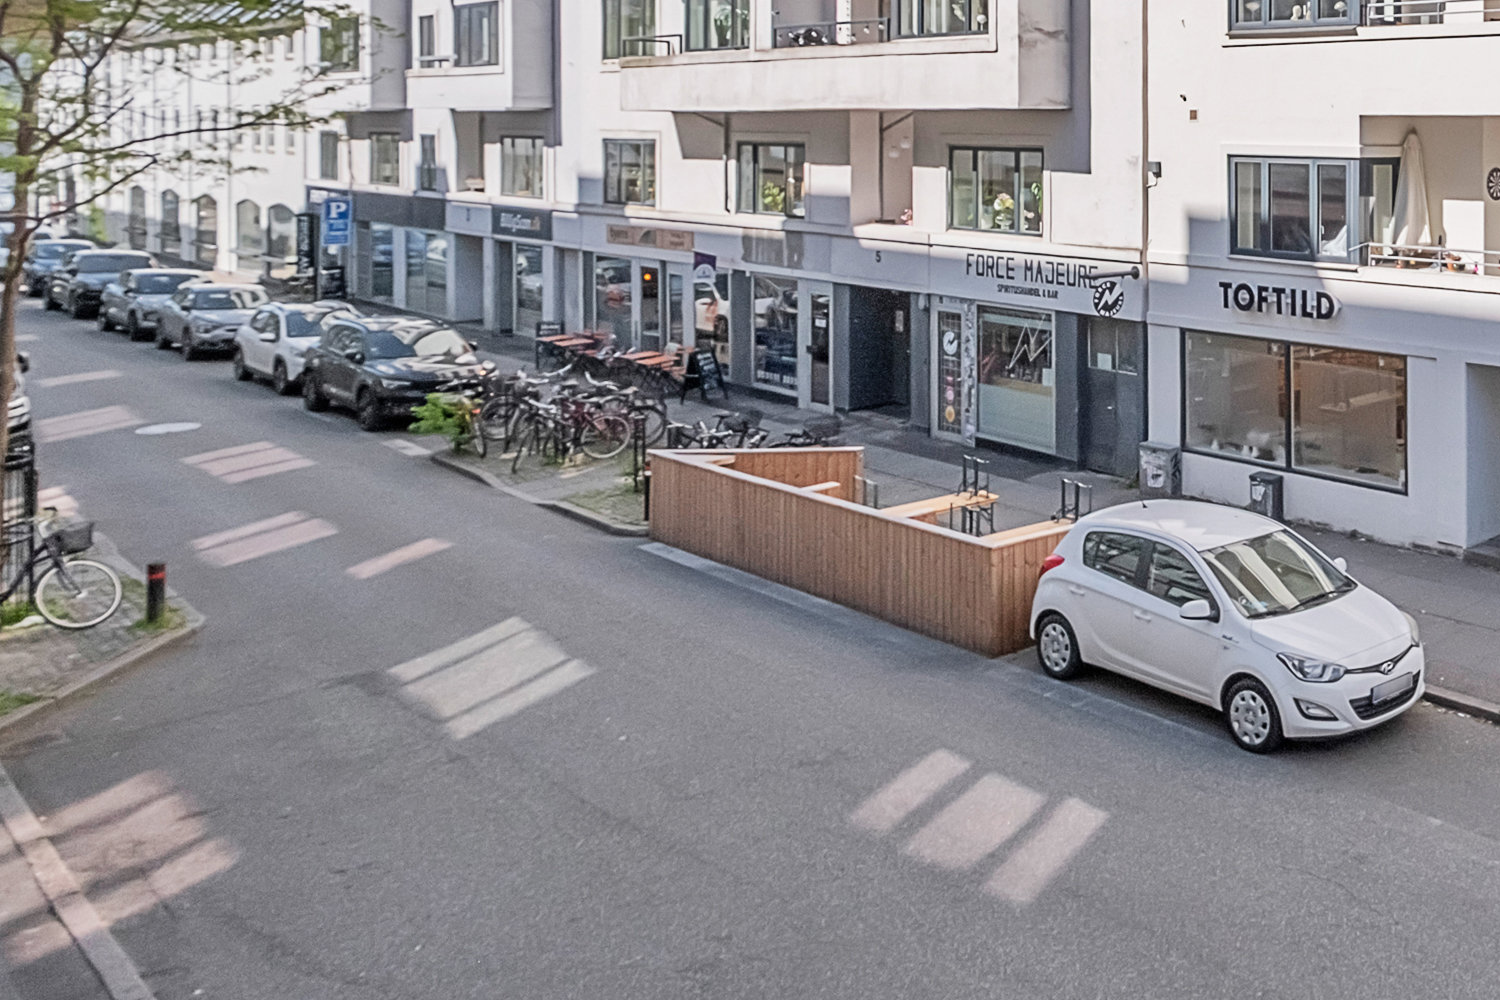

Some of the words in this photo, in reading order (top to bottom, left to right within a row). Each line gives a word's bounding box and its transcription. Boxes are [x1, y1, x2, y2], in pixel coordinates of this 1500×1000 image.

[328, 202, 348, 219] P
[875, 250, 882, 263] 5
[966, 253, 1015, 280] FORCE
[1219, 281, 1336, 320] TOFTILD
